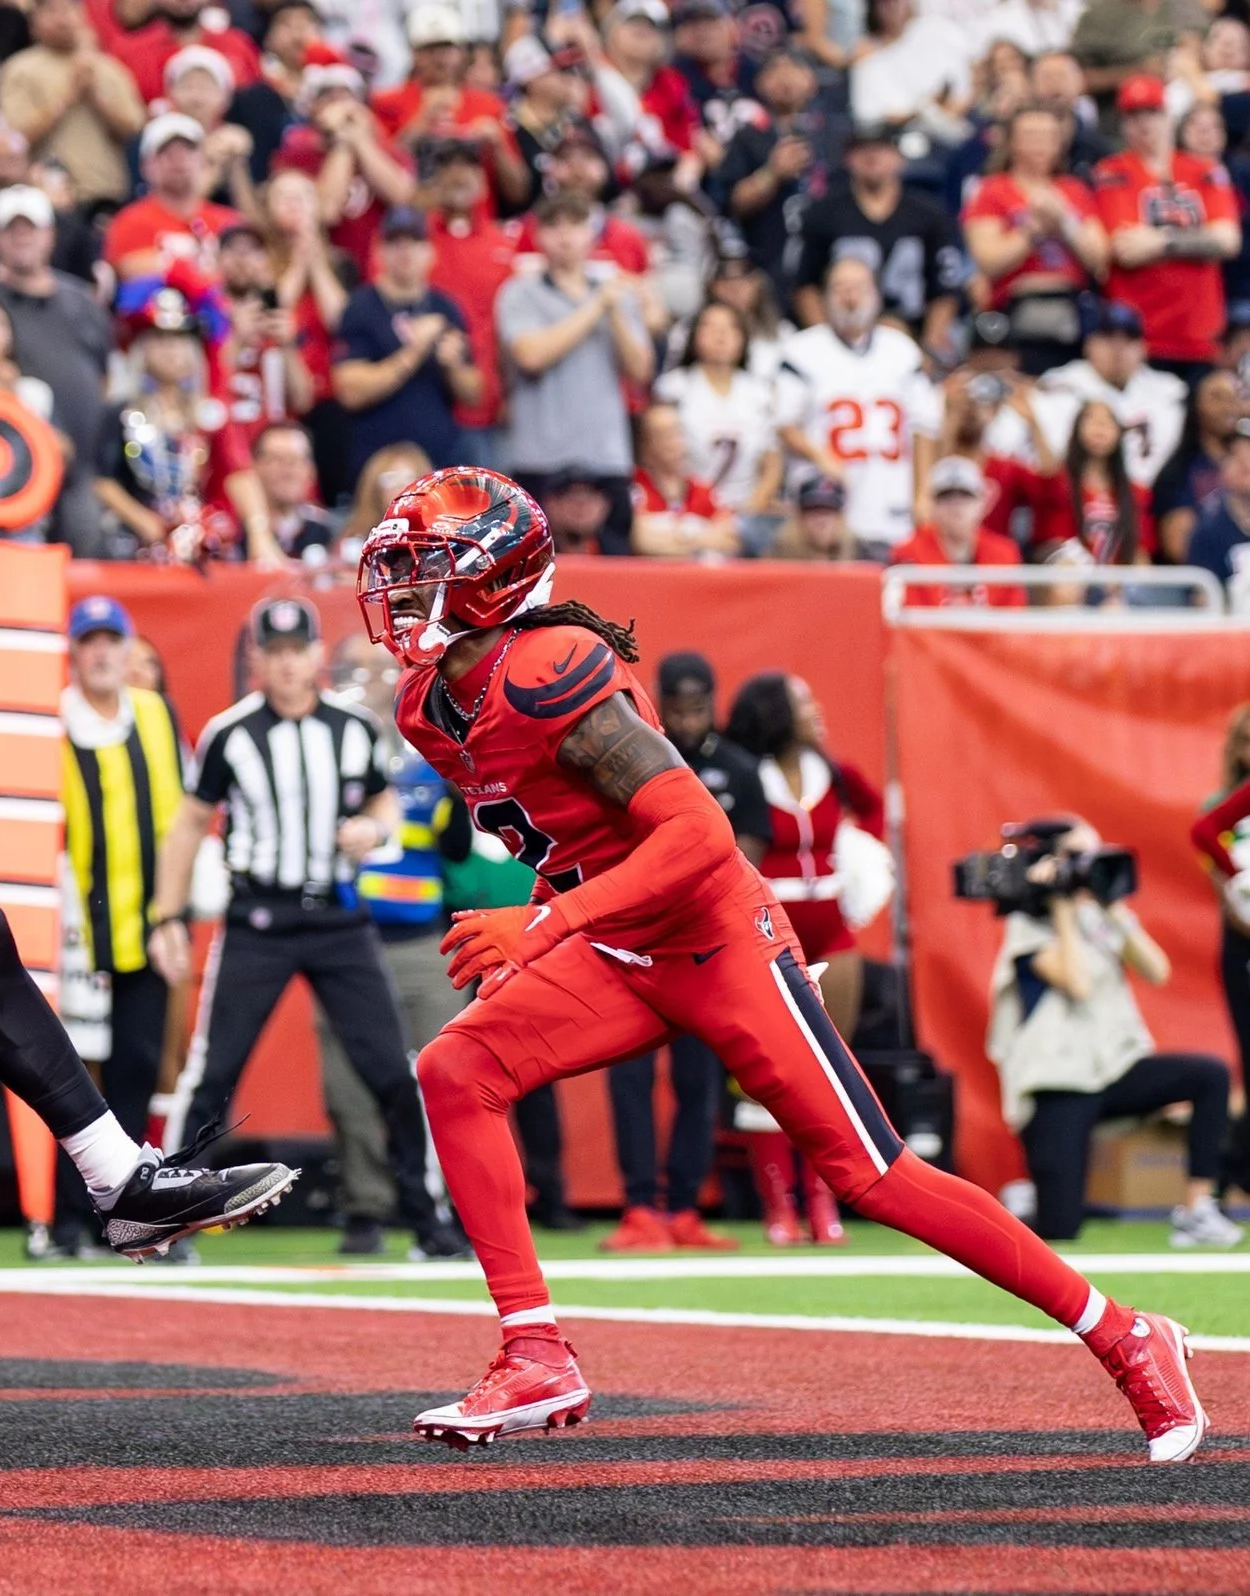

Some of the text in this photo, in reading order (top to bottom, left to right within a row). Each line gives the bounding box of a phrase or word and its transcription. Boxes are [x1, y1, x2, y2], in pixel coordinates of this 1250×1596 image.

[827, 397, 906, 461] 23
[460, 781, 507, 795] TEXANS
[473, 797, 584, 895] 2
